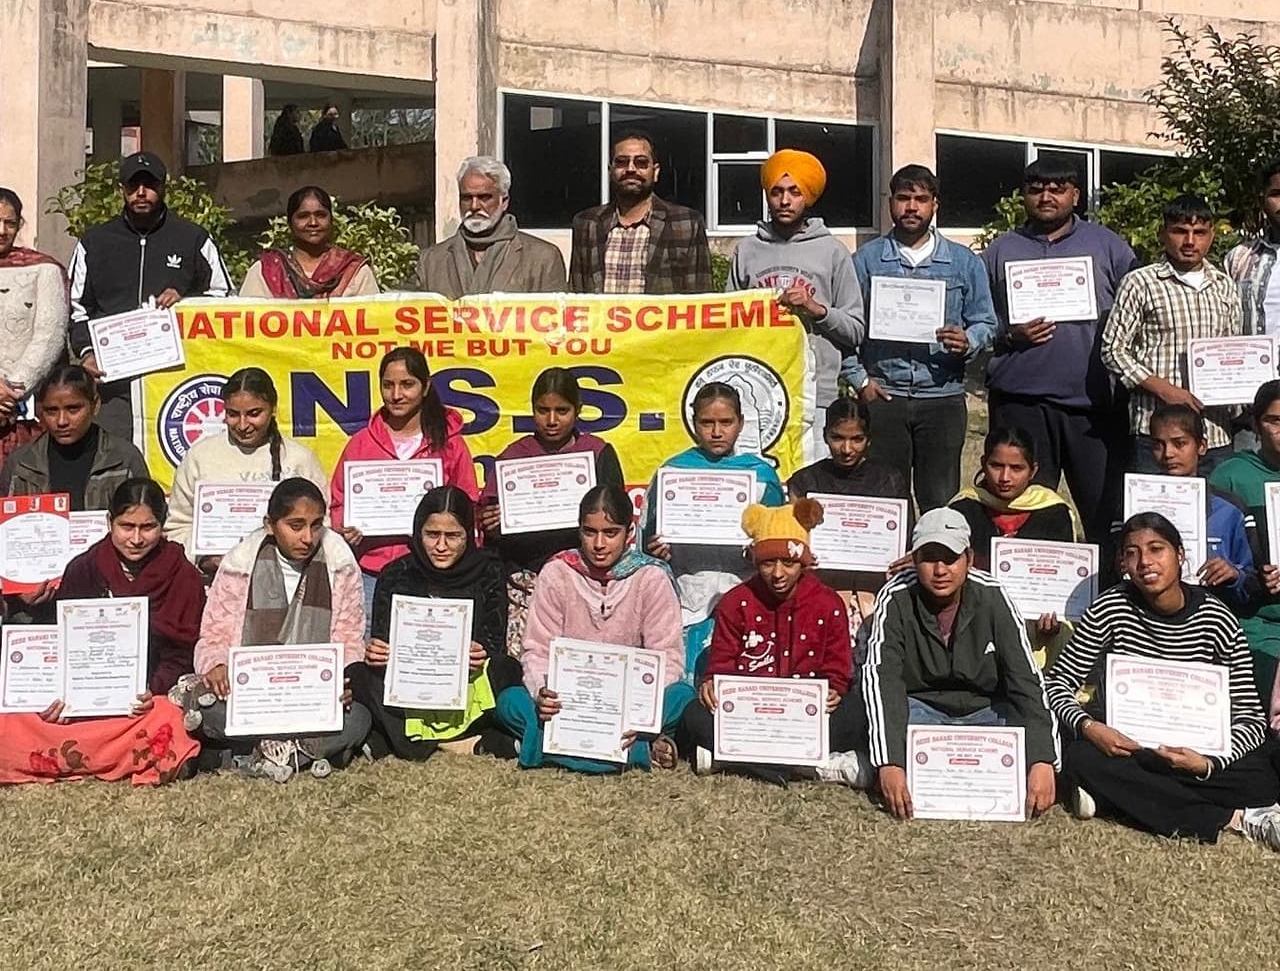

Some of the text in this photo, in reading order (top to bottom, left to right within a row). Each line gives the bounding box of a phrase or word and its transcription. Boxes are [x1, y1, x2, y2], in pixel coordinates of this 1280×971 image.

[395, 305, 589, 334] SERVICE
[606, 300, 795, 333] SCHEME
[409, 340, 455, 358] ME
[467, 338, 532, 357] BUT
[545, 338, 612, 356] YOU
